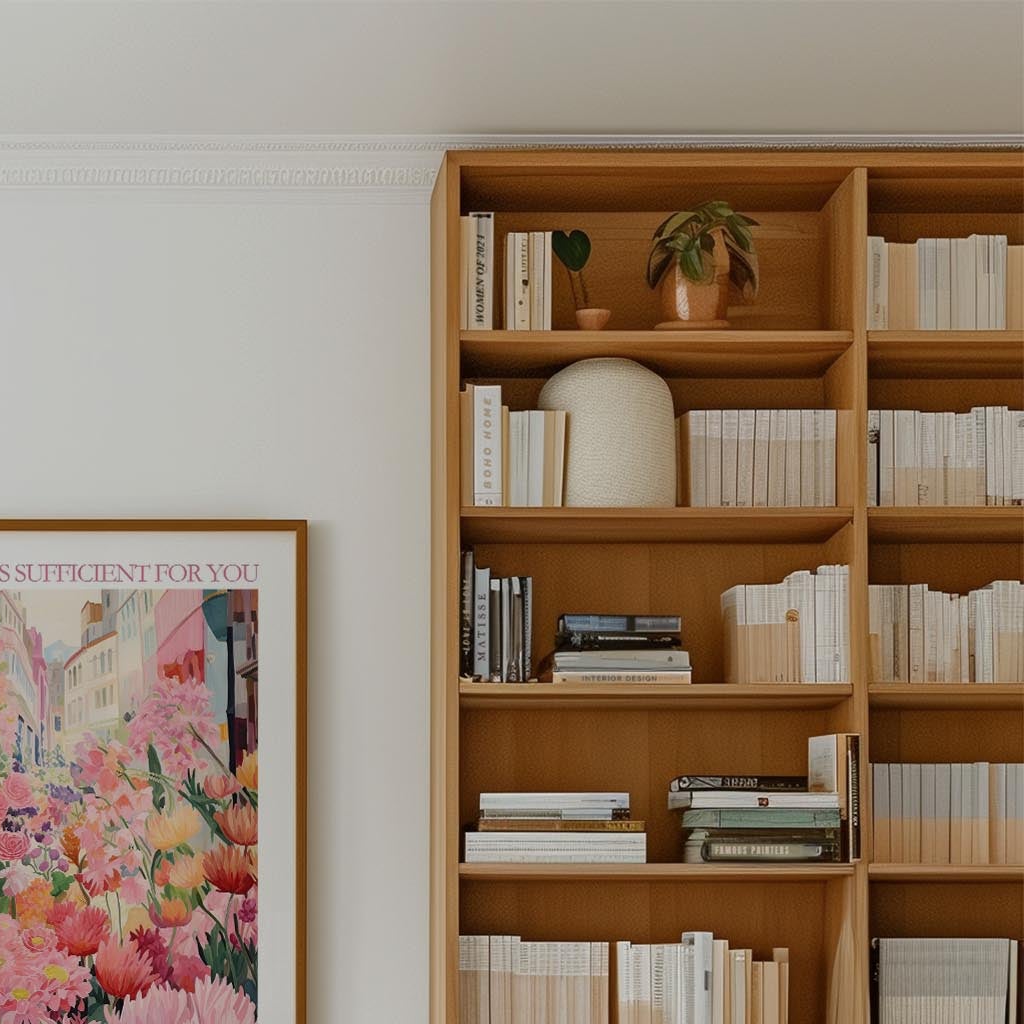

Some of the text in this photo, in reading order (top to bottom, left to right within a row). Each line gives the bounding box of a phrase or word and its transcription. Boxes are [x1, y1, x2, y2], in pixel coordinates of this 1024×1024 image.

[475, 259, 485, 275] OF
[475, 278, 485, 323] WOMEN
[483, 397, 492, 489] BOHO HOME
[15, 564, 151, 582] SUFFICIENT
[154, 564, 203, 582] FOR
[206, 564, 259, 582] YOU
[477, 593, 486, 661] MATISSE
[714, 846, 789, 854] FAMOUS PAINTERS
